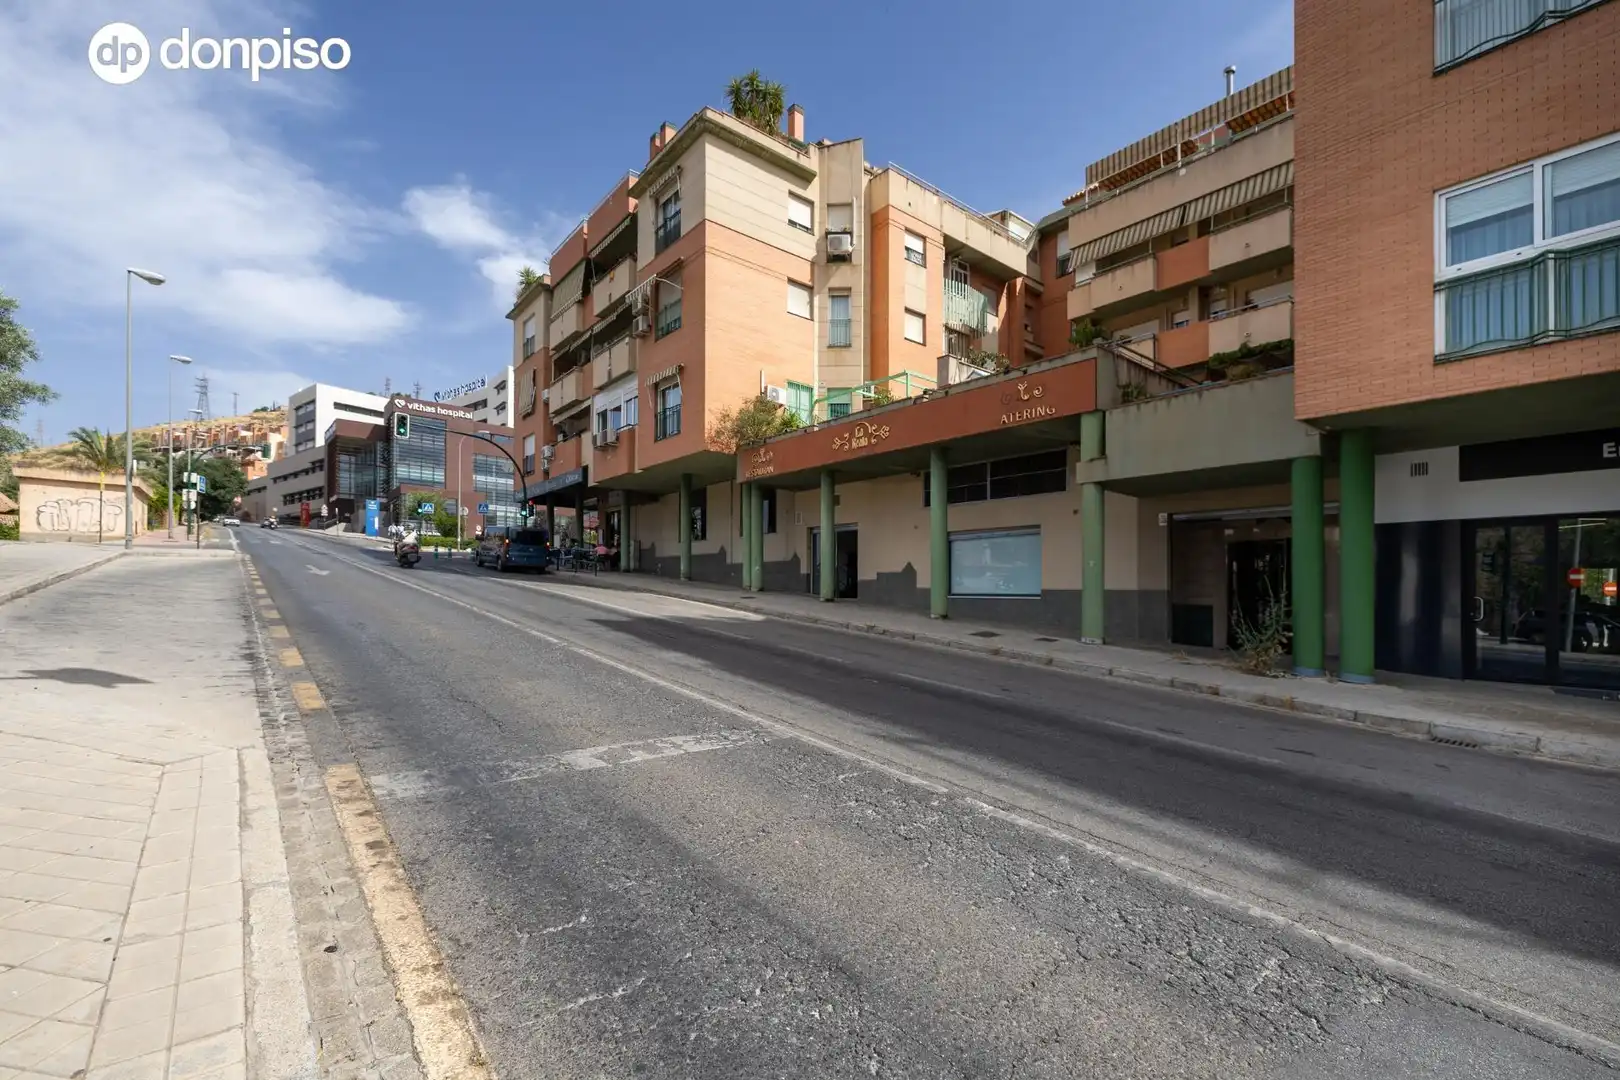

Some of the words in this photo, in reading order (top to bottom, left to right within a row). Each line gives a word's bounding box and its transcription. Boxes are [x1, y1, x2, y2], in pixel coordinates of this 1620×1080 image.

[407, 402, 436, 413] vithas
[437, 406, 473, 419] hospital
[1000, 405, 1056, 424] ATERING
